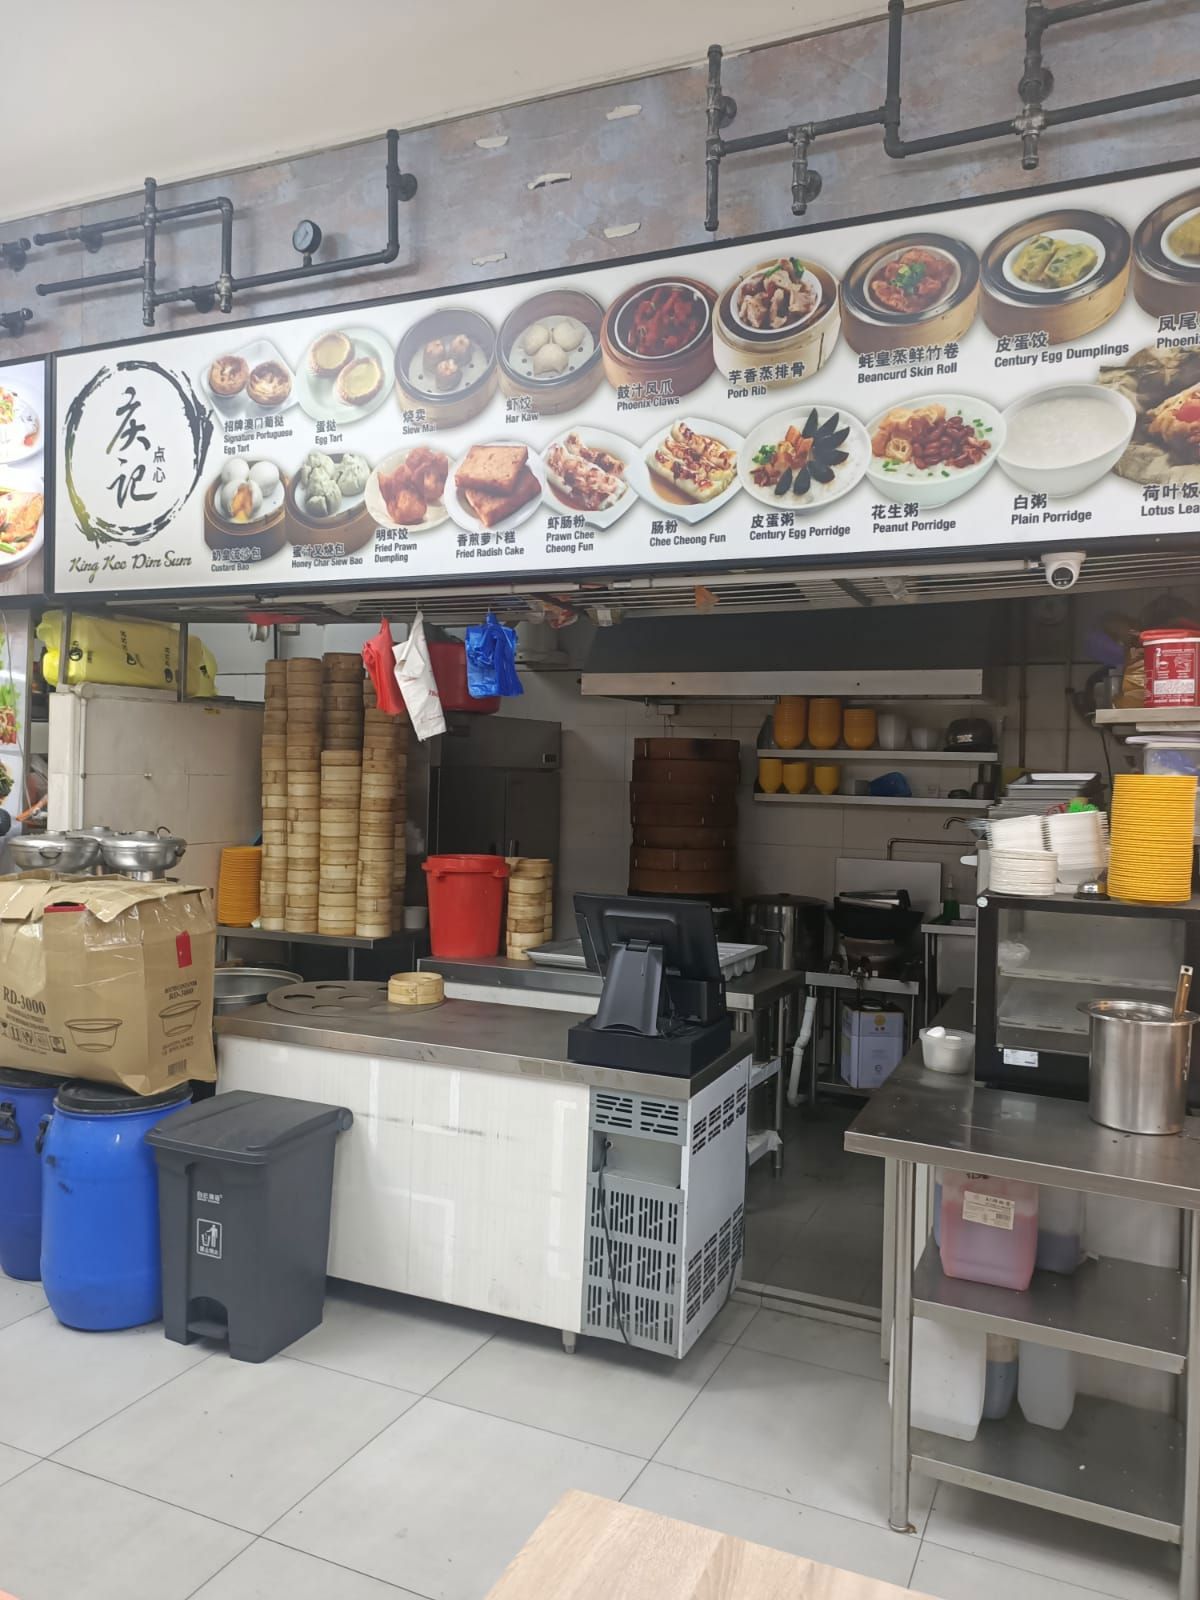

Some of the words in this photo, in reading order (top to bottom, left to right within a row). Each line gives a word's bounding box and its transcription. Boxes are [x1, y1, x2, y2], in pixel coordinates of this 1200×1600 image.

[1158, 312, 1200, 333] 凤尾
[995, 332, 1049, 353] 皮蛋饺
[1156, 333, 1200, 349] Phoeni
[858, 342, 960, 369] 蚝皇蒸鲜竹卷
[994, 353, 1038, 368] Century
[1041, 351, 1063, 363] Egg
[1066, 343, 1129, 360] Dumplings
[728, 361, 805, 385] 芋香蒸排骨
[857, 368, 907, 383] Beancurd
[910, 365, 934, 378] Skin
[936, 362, 958, 374] Roll
[751, 385, 767, 396] Rib
[506, 396, 532, 411] 虾饺
[616, 398, 652, 411] Phoenix
[653, 396, 680, 407] Claws
[505, 414, 519, 424] Har
[521, 412, 539, 423] Kaw
[223, 433, 255, 444] Signature
[256, 429, 293, 440] Portuguese
[402, 426, 420, 435] Siew
[315, 435, 328, 445] Egg
[329, 434, 343, 443] Tart
[223, 445, 236, 455] Egg
[237, 443, 250, 453] Tart
[152, 446, 166, 483] 点心
[1142, 482, 1200, 502] 荷叶饭
[1013, 493, 1048, 510] 白粥
[871, 503, 919, 520] 花生粥
[1011, 512, 1040, 525] Plain
[1042, 510, 1093, 524] Porridge
[1140, 504, 1175, 517] Lotus
[1178, 503, 1200, 515] Lea
[547, 515, 585, 530] 虾肠粉
[650, 520, 678, 535] 肠粉
[750, 512, 795, 529] 皮蛋粥
[872, 520, 909, 533] Peanut
[911, 518, 957, 531] Porridge
[376, 528, 409, 542] 明虾饺
[457, 530, 516, 547] 香煎萝卜糕
[546, 531, 572, 542] Prawn
[574, 530, 595, 540] Chee
[649, 536, 672, 547] Chee
[673, 535, 707, 546] Cheong
[709, 533, 727, 543] Fun
[749, 529, 786, 541] Century
[788, 528, 806, 539] Egg
[808, 525, 851, 537] Porridge
[374, 543, 393, 553] Fried
[394, 542, 417, 551] Prawn
[456, 549, 475, 559] Fried
[476, 547, 502, 557] Radish
[505, 546, 525, 555] Cake
[545, 543, 576, 554] Cheong
[578, 541, 594, 551] Fun
[291, 559, 312, 569] Honey
[313, 558, 329, 567] Char
[331, 558, 348, 566] Siew
[350, 556, 363, 565] Bao
[374, 553, 409, 563] Dumpling
[68, 556, 99, 584] King
[131, 553, 162, 570] Dim
[163, 550, 192, 568] Sum
[211, 563, 236, 573] Custard
[237, 562, 250, 571] Bao
[3, 986, 46, 1016] RD-3000
